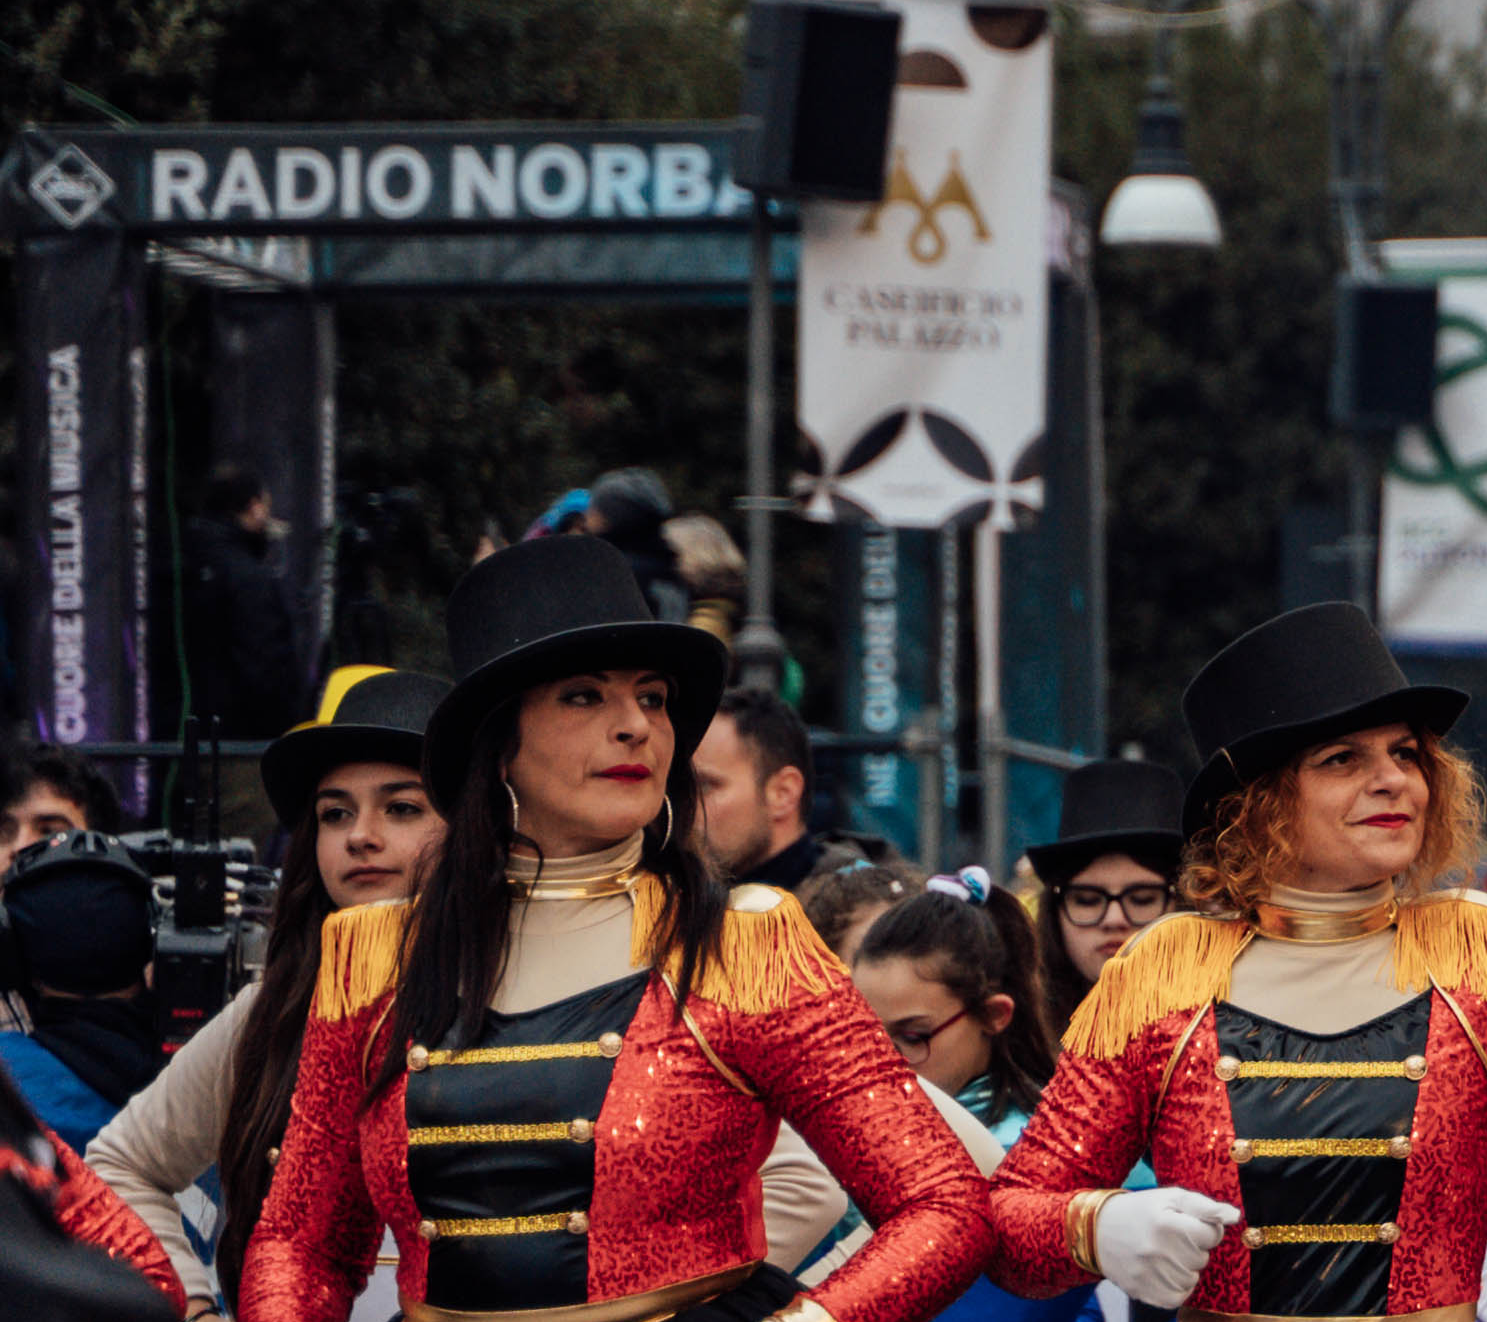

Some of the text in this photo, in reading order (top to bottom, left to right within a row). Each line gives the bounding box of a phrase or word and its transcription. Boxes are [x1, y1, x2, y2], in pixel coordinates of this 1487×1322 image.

[152, 144, 431, 220] RADIO
[846, 319, 1003, 351] PALAZZO
[48, 345, 87, 744] CUORE DELLA MUSICA
[861, 600, 898, 730] CUORE
